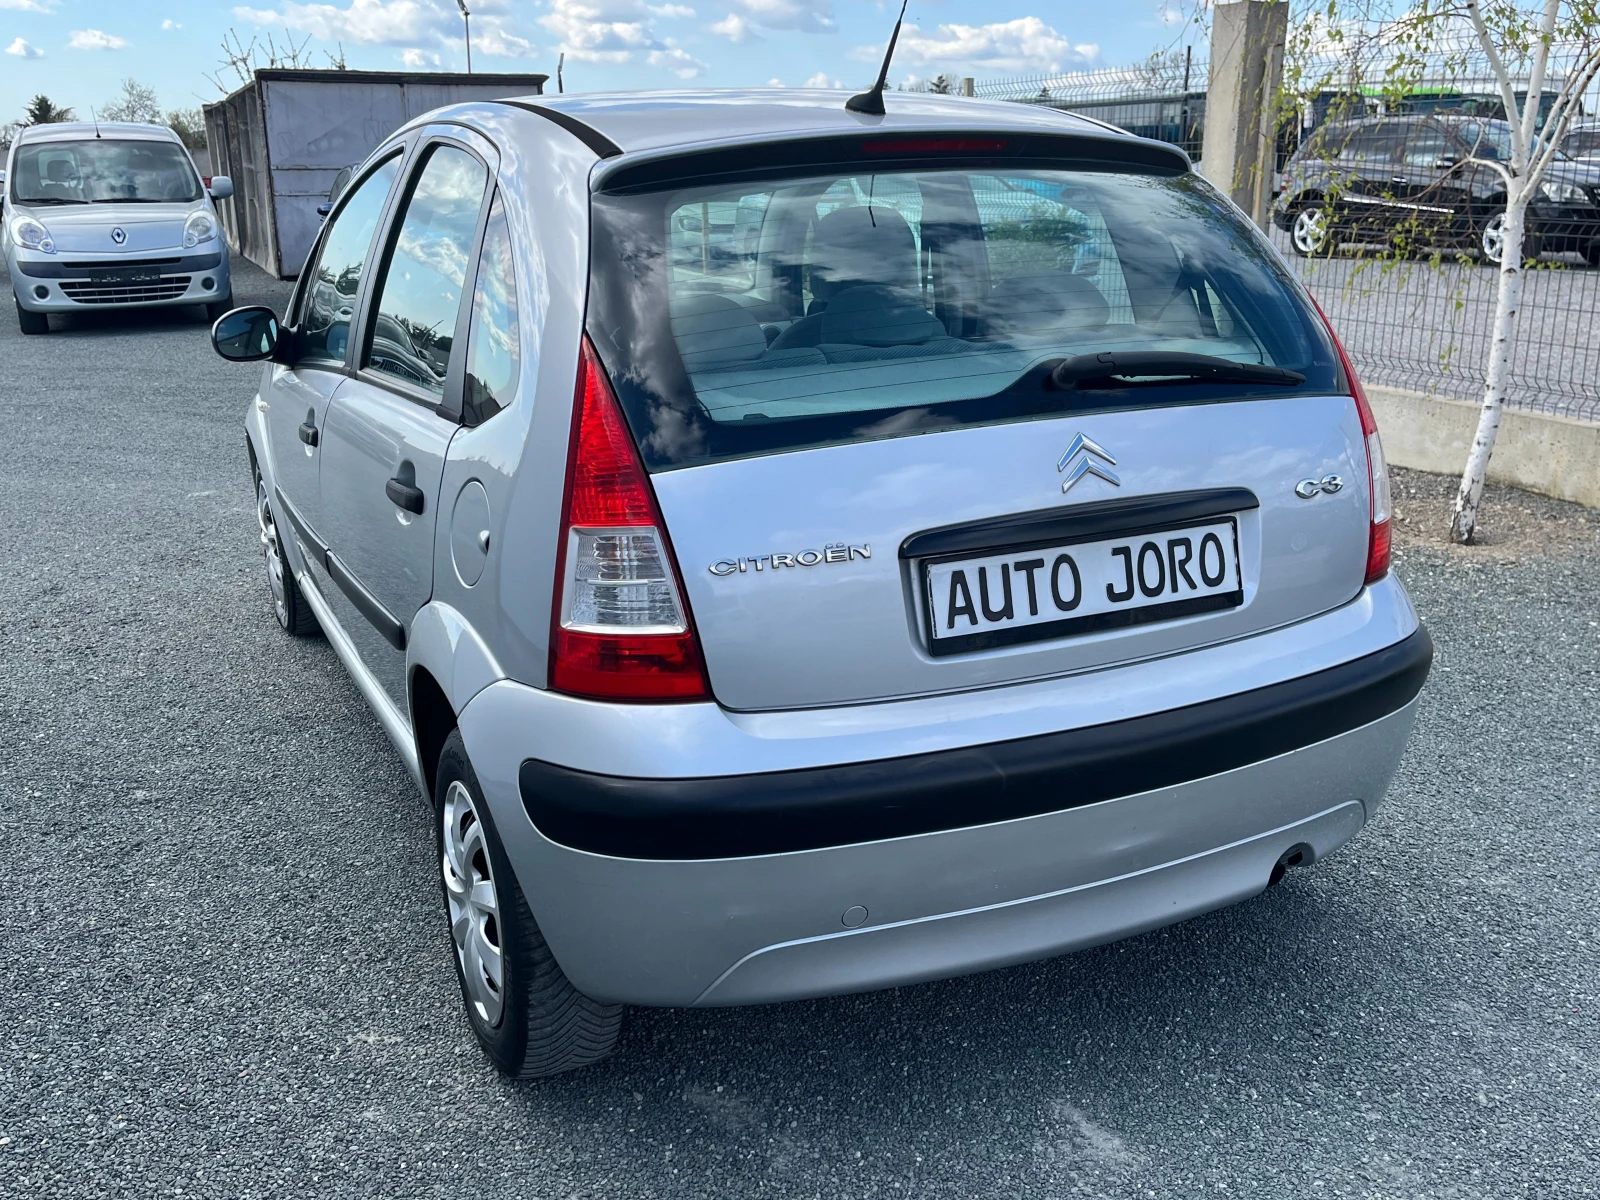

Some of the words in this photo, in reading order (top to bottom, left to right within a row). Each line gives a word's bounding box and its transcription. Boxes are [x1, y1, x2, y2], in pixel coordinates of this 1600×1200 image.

[1295, 473, 1343, 499] C3
[708, 542, 872, 576] CITROËN
[947, 553, 1082, 629] AUTO
[1106, 532, 1226, 603] JORO
